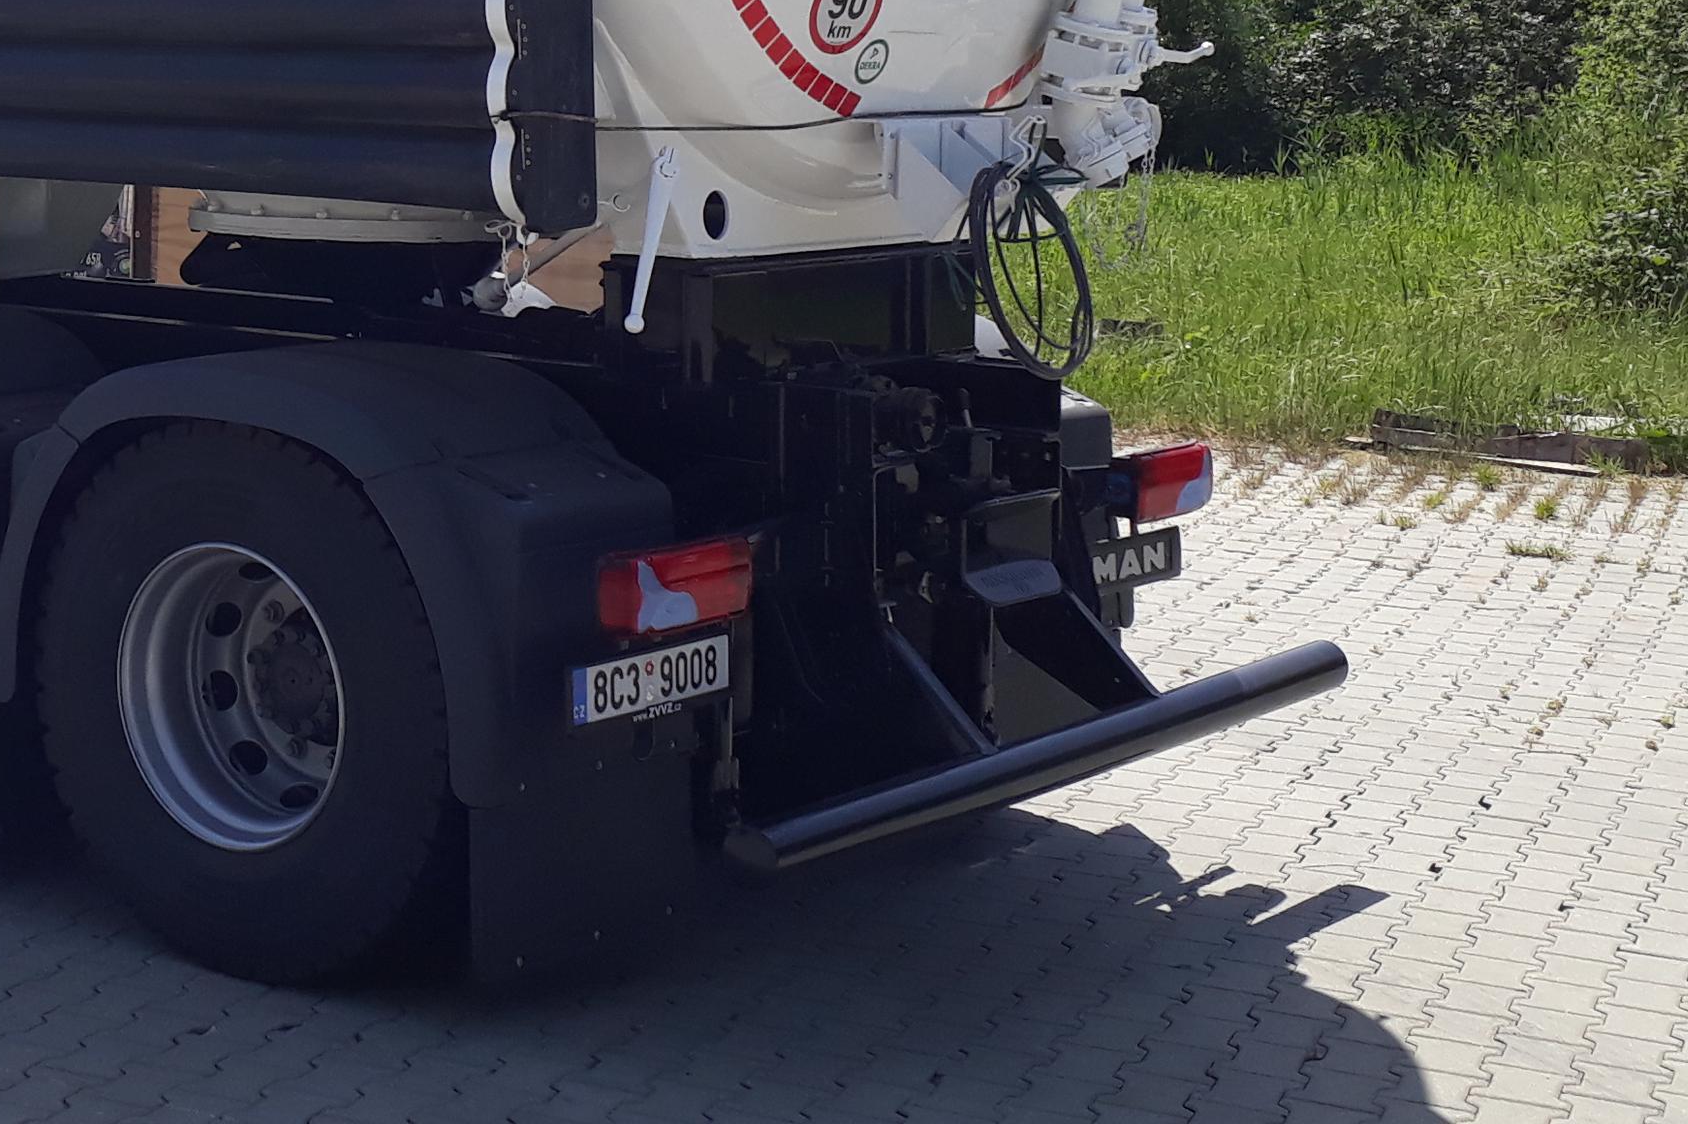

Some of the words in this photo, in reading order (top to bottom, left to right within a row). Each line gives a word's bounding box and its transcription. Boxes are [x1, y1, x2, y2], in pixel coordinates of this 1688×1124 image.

[827, 20, 852, 39] km
[1092, 541, 1166, 584] MAN
[593, 662, 641, 714] 8C3
[659, 644, 718, 697] 9008
[573, 704, 586, 720] CZ
